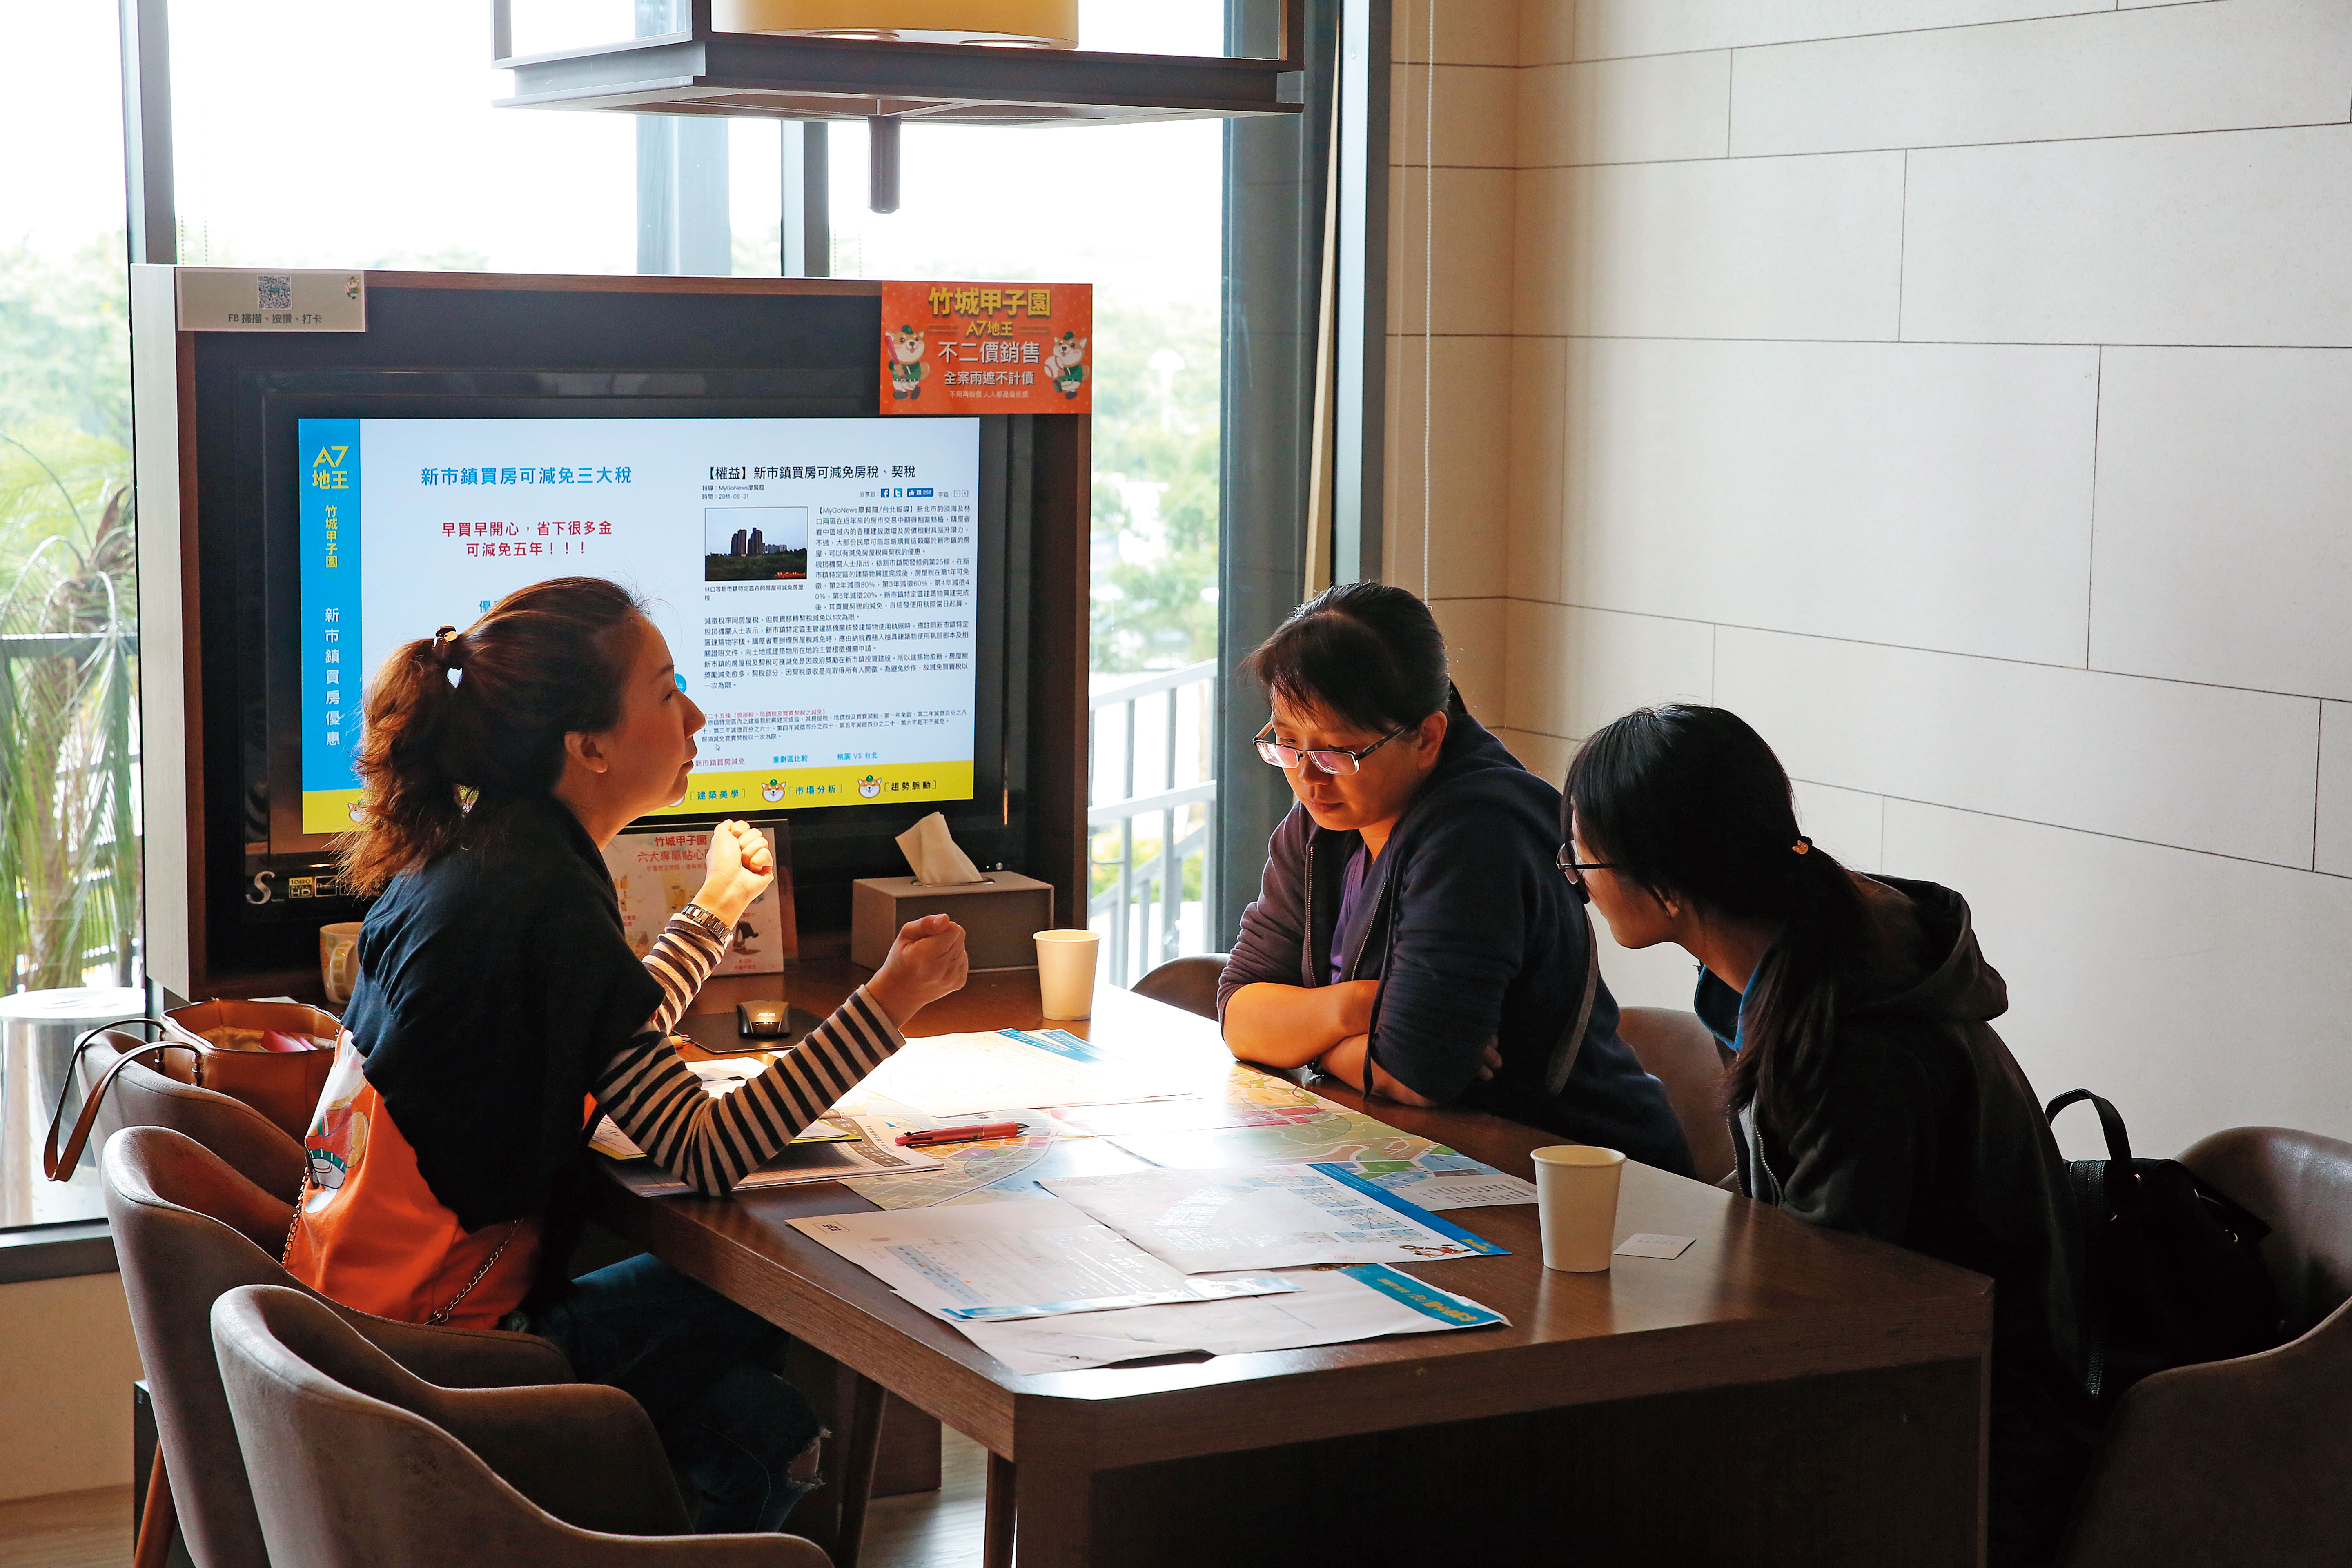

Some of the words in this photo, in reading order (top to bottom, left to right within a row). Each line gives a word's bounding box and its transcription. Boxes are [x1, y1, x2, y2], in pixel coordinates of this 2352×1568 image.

[929, 287, 1051, 317] 竹城甲子園
[965, 320, 1013, 336] A7地王
[938, 341, 1040, 364] 不二價銷售
[944, 371, 1034, 385] 全案雨遮不計價
[313, 445, 349, 468] A7
[312, 470, 349, 489] 地王
[421, 467, 632, 486] 新市鎮買房可減免三大稅
[325, 505, 338, 568] 竹城甲子園
[442, 521, 612, 538] 早買早開心，省下很多金
[325, 608, 340, 746] 新市鎮買房優惠
[655, 835, 707, 846] 竹城甲子園
